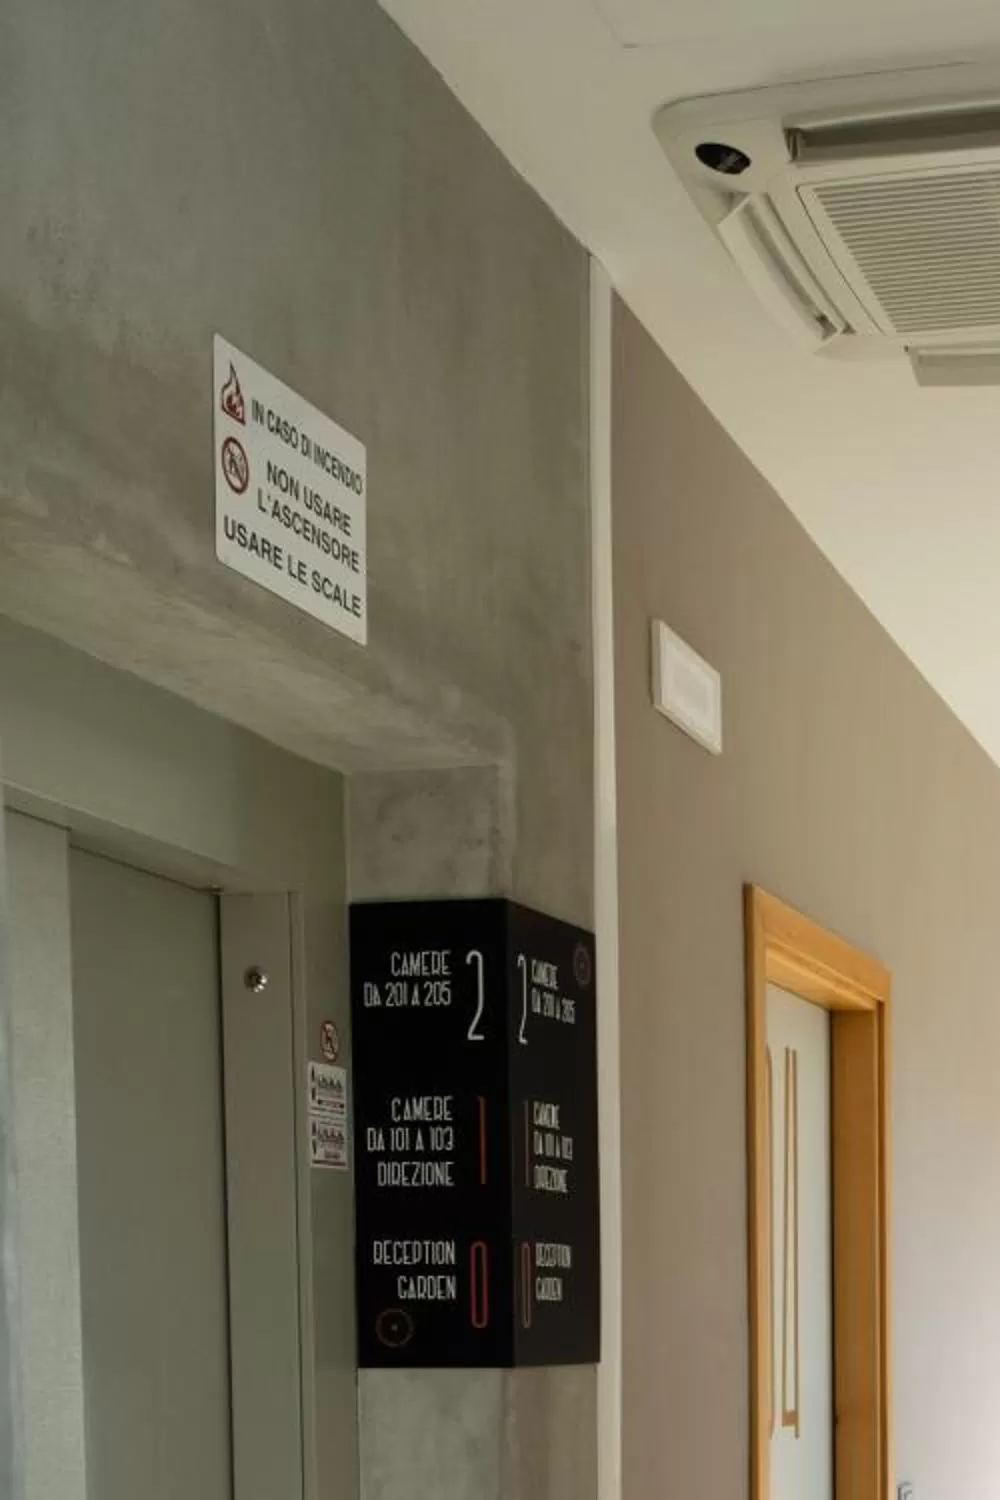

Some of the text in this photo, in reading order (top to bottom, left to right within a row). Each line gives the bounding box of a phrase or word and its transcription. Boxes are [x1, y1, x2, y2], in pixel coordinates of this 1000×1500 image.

[251, 398, 363, 496] IN CASO DI INCENDIO
[267, 459, 352, 537] NON USARE
[258, 487, 360, 574] L'ASCENSORE
[224, 515, 361, 618] USARE LE SCALE
[391, 950, 452, 977] CAMERE
[363, 980, 451, 1008] DA 201 A 205
[466, 949, 485, 1041] 2
[517, 953, 528, 1045] 2
[391, 1096, 453, 1122] CAMERE
[367, 1127, 385, 1151] DA
[390, 1127, 410, 1151] 101
[415, 1127, 425, 1151] A
[430, 1126, 454, 1151] 103
[377, 1161, 455, 1187] DIREZIONE
[373, 1240, 456, 1265] RECEPTION
[397, 1275, 456, 1300] GARDEN
